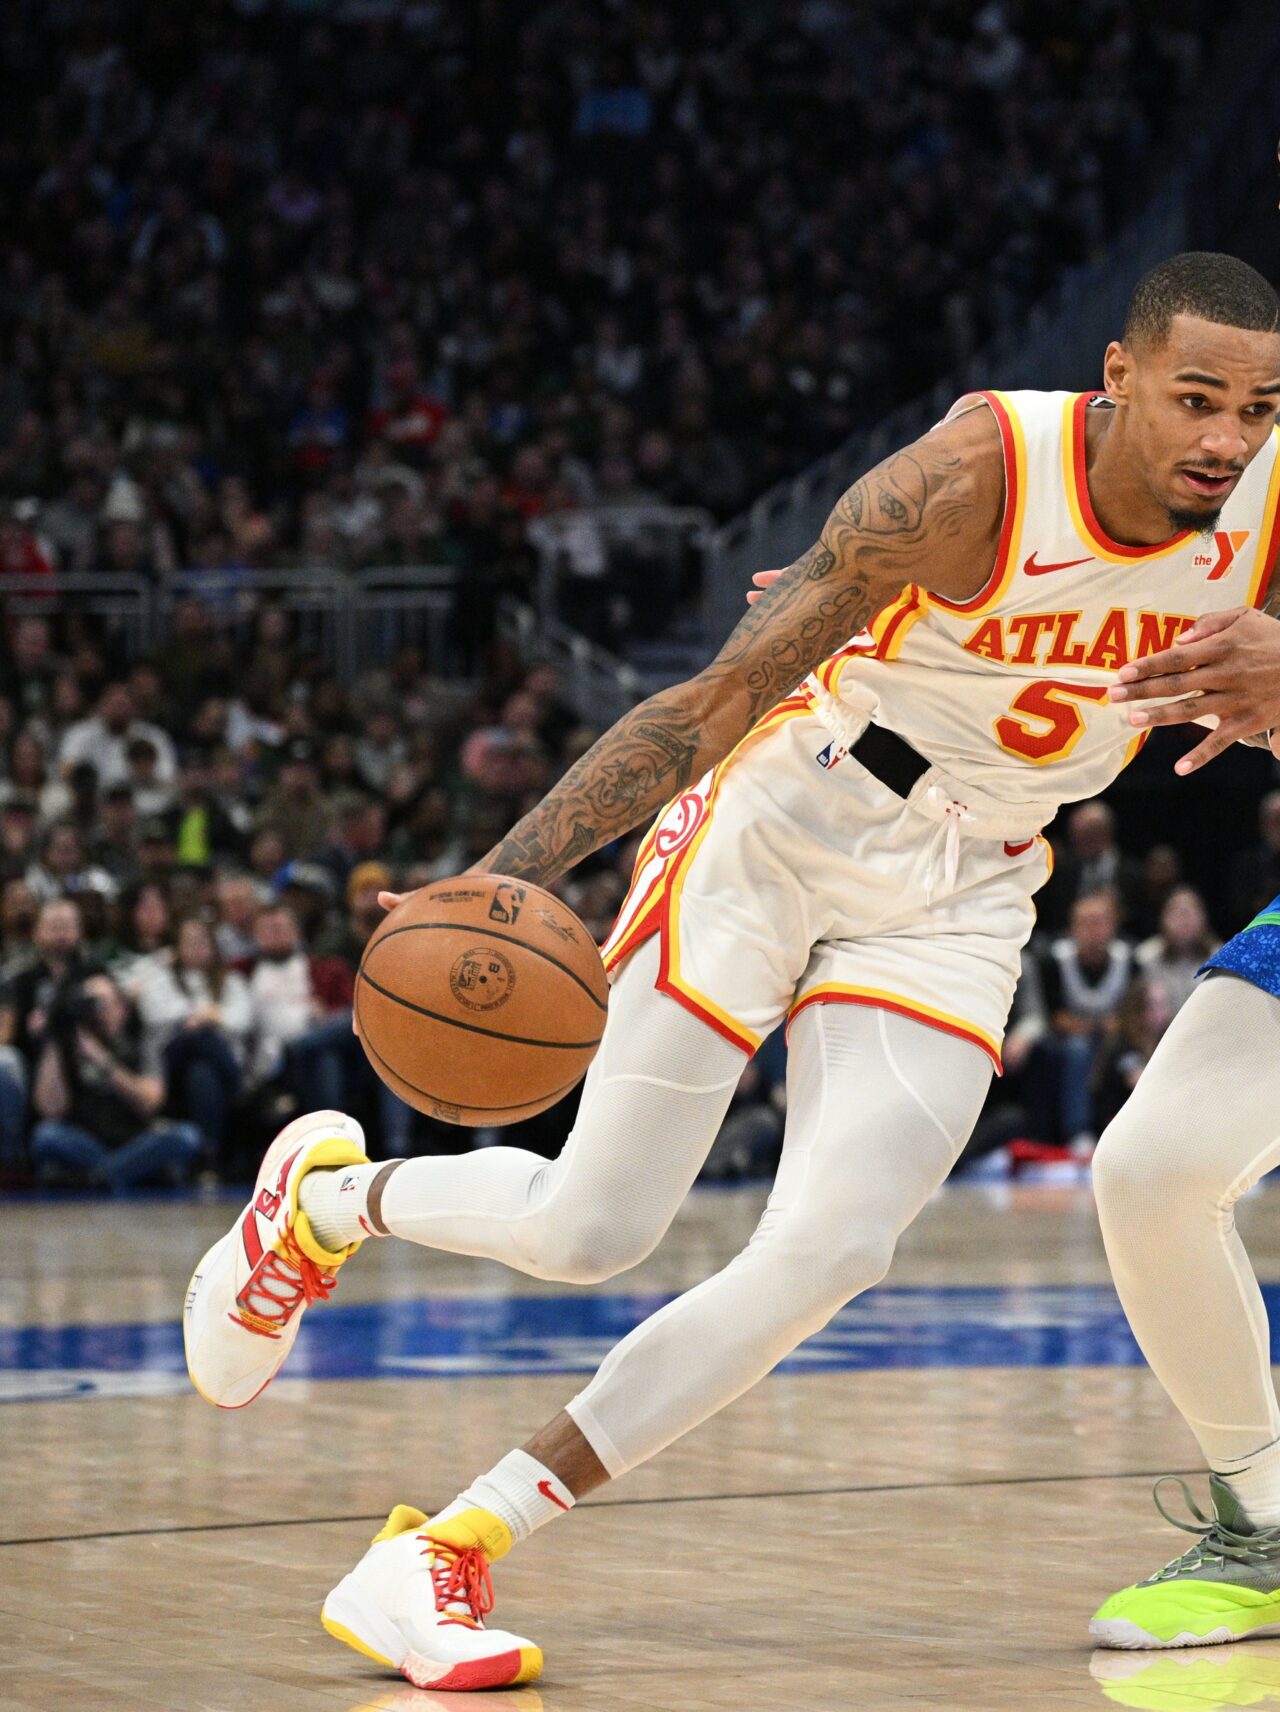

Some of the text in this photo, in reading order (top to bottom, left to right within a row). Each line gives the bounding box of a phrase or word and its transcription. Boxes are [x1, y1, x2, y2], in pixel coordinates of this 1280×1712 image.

[1194, 554, 1212, 566] the
[962, 606, 1199, 671] ATLAN
[992, 680, 1110, 766] 5
